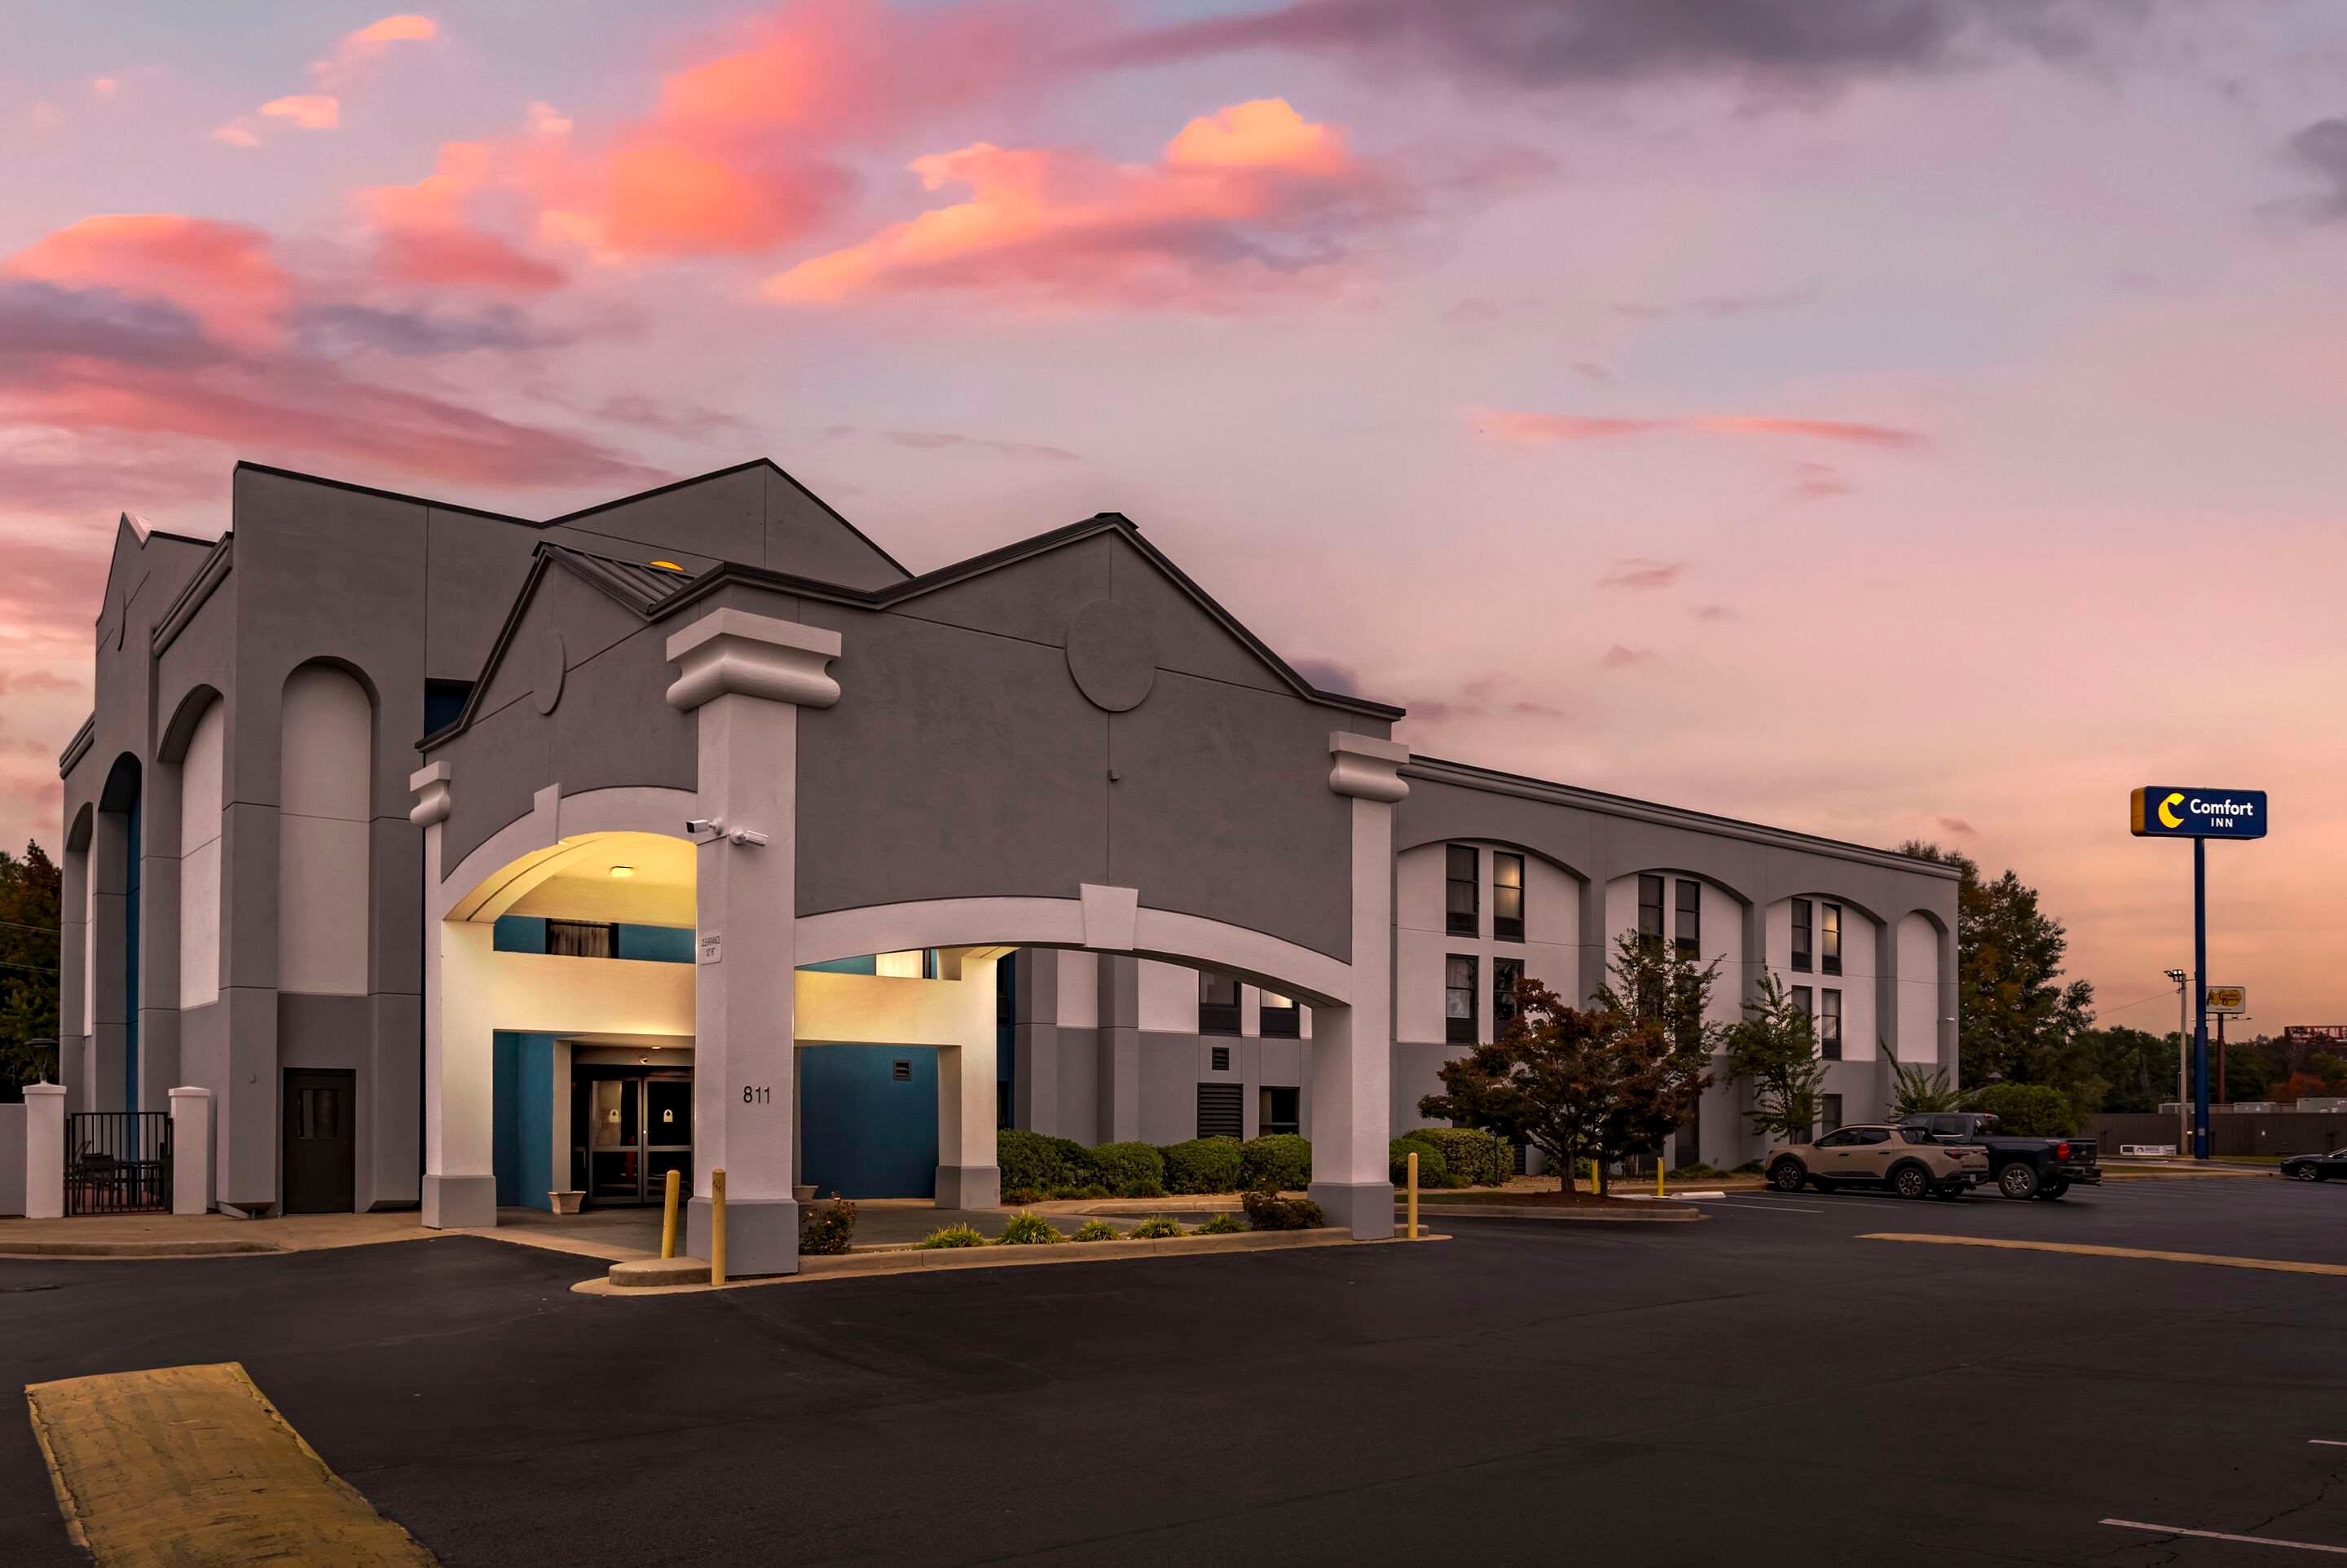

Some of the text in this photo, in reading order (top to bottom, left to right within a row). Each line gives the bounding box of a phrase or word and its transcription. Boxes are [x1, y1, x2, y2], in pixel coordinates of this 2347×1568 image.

[2190, 798, 2254, 816] Comfort
[2211, 817, 2234, 828] INN
[743, 1086, 770, 1103] 811
